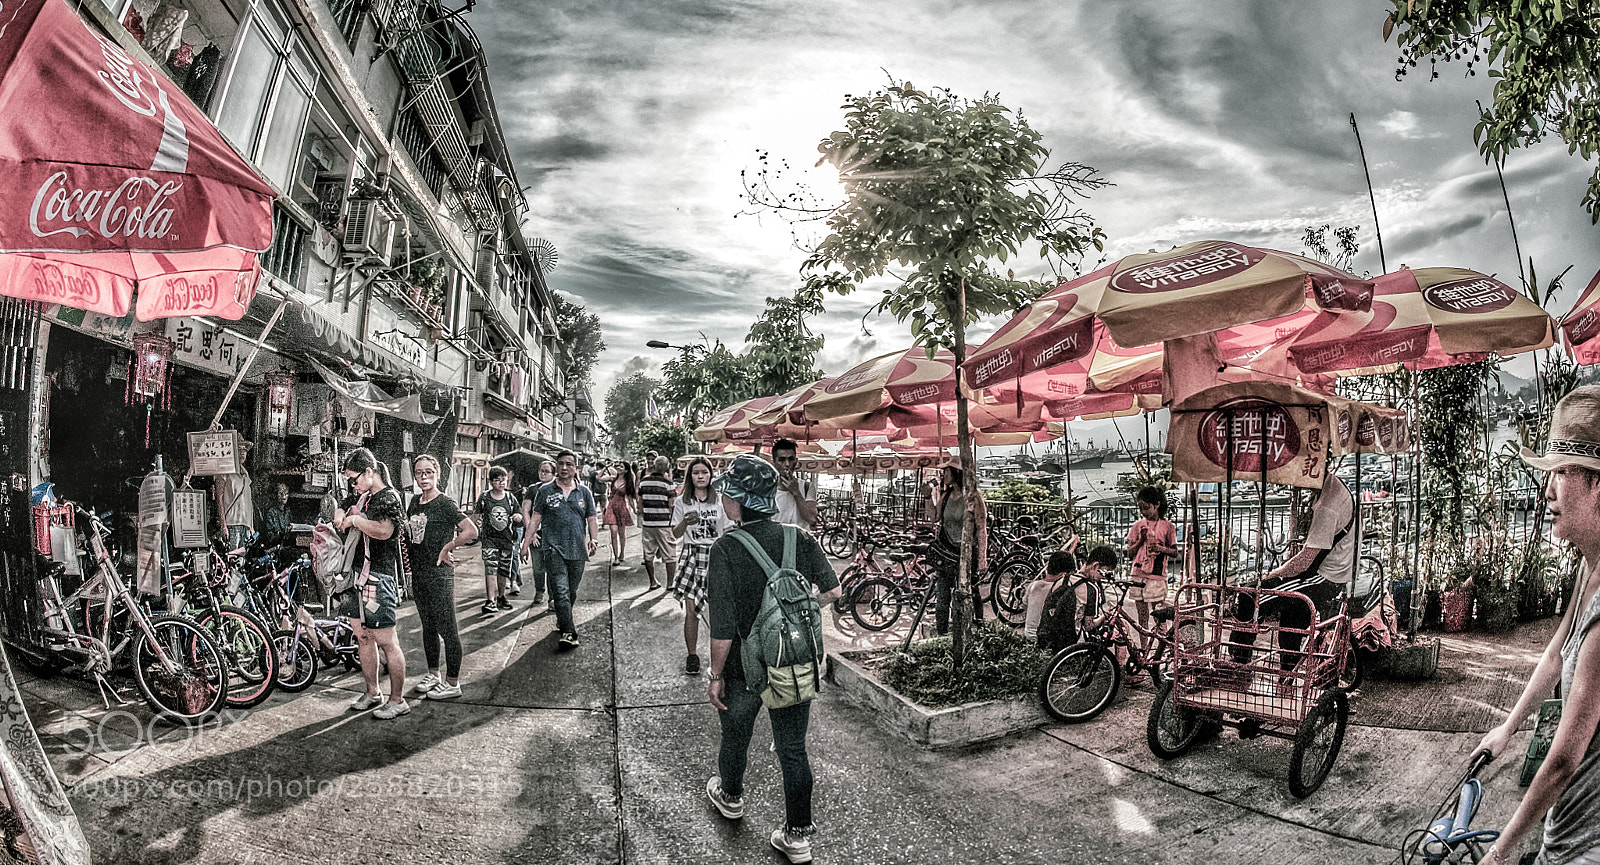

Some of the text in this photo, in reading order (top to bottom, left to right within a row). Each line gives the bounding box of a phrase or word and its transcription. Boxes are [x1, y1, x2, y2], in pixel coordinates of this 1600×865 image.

[29, 171, 184, 240] Coca-Cola
[1130, 247, 1243, 282] 維他奶
[1139, 254, 1250, 289] vitasoy
[1433, 279, 1500, 302] 維他奶
[1446, 289, 1510, 310] vitasoy
[1033, 333, 1078, 367] vitasoy
[1304, 343, 1346, 369] 維他奶
[1368, 339, 1414, 362] vitasoy
[975, 348, 1013, 385] 維他奶
[900, 384, 939, 404] 維他奶
[1130, 379, 1162, 391] vitaso
